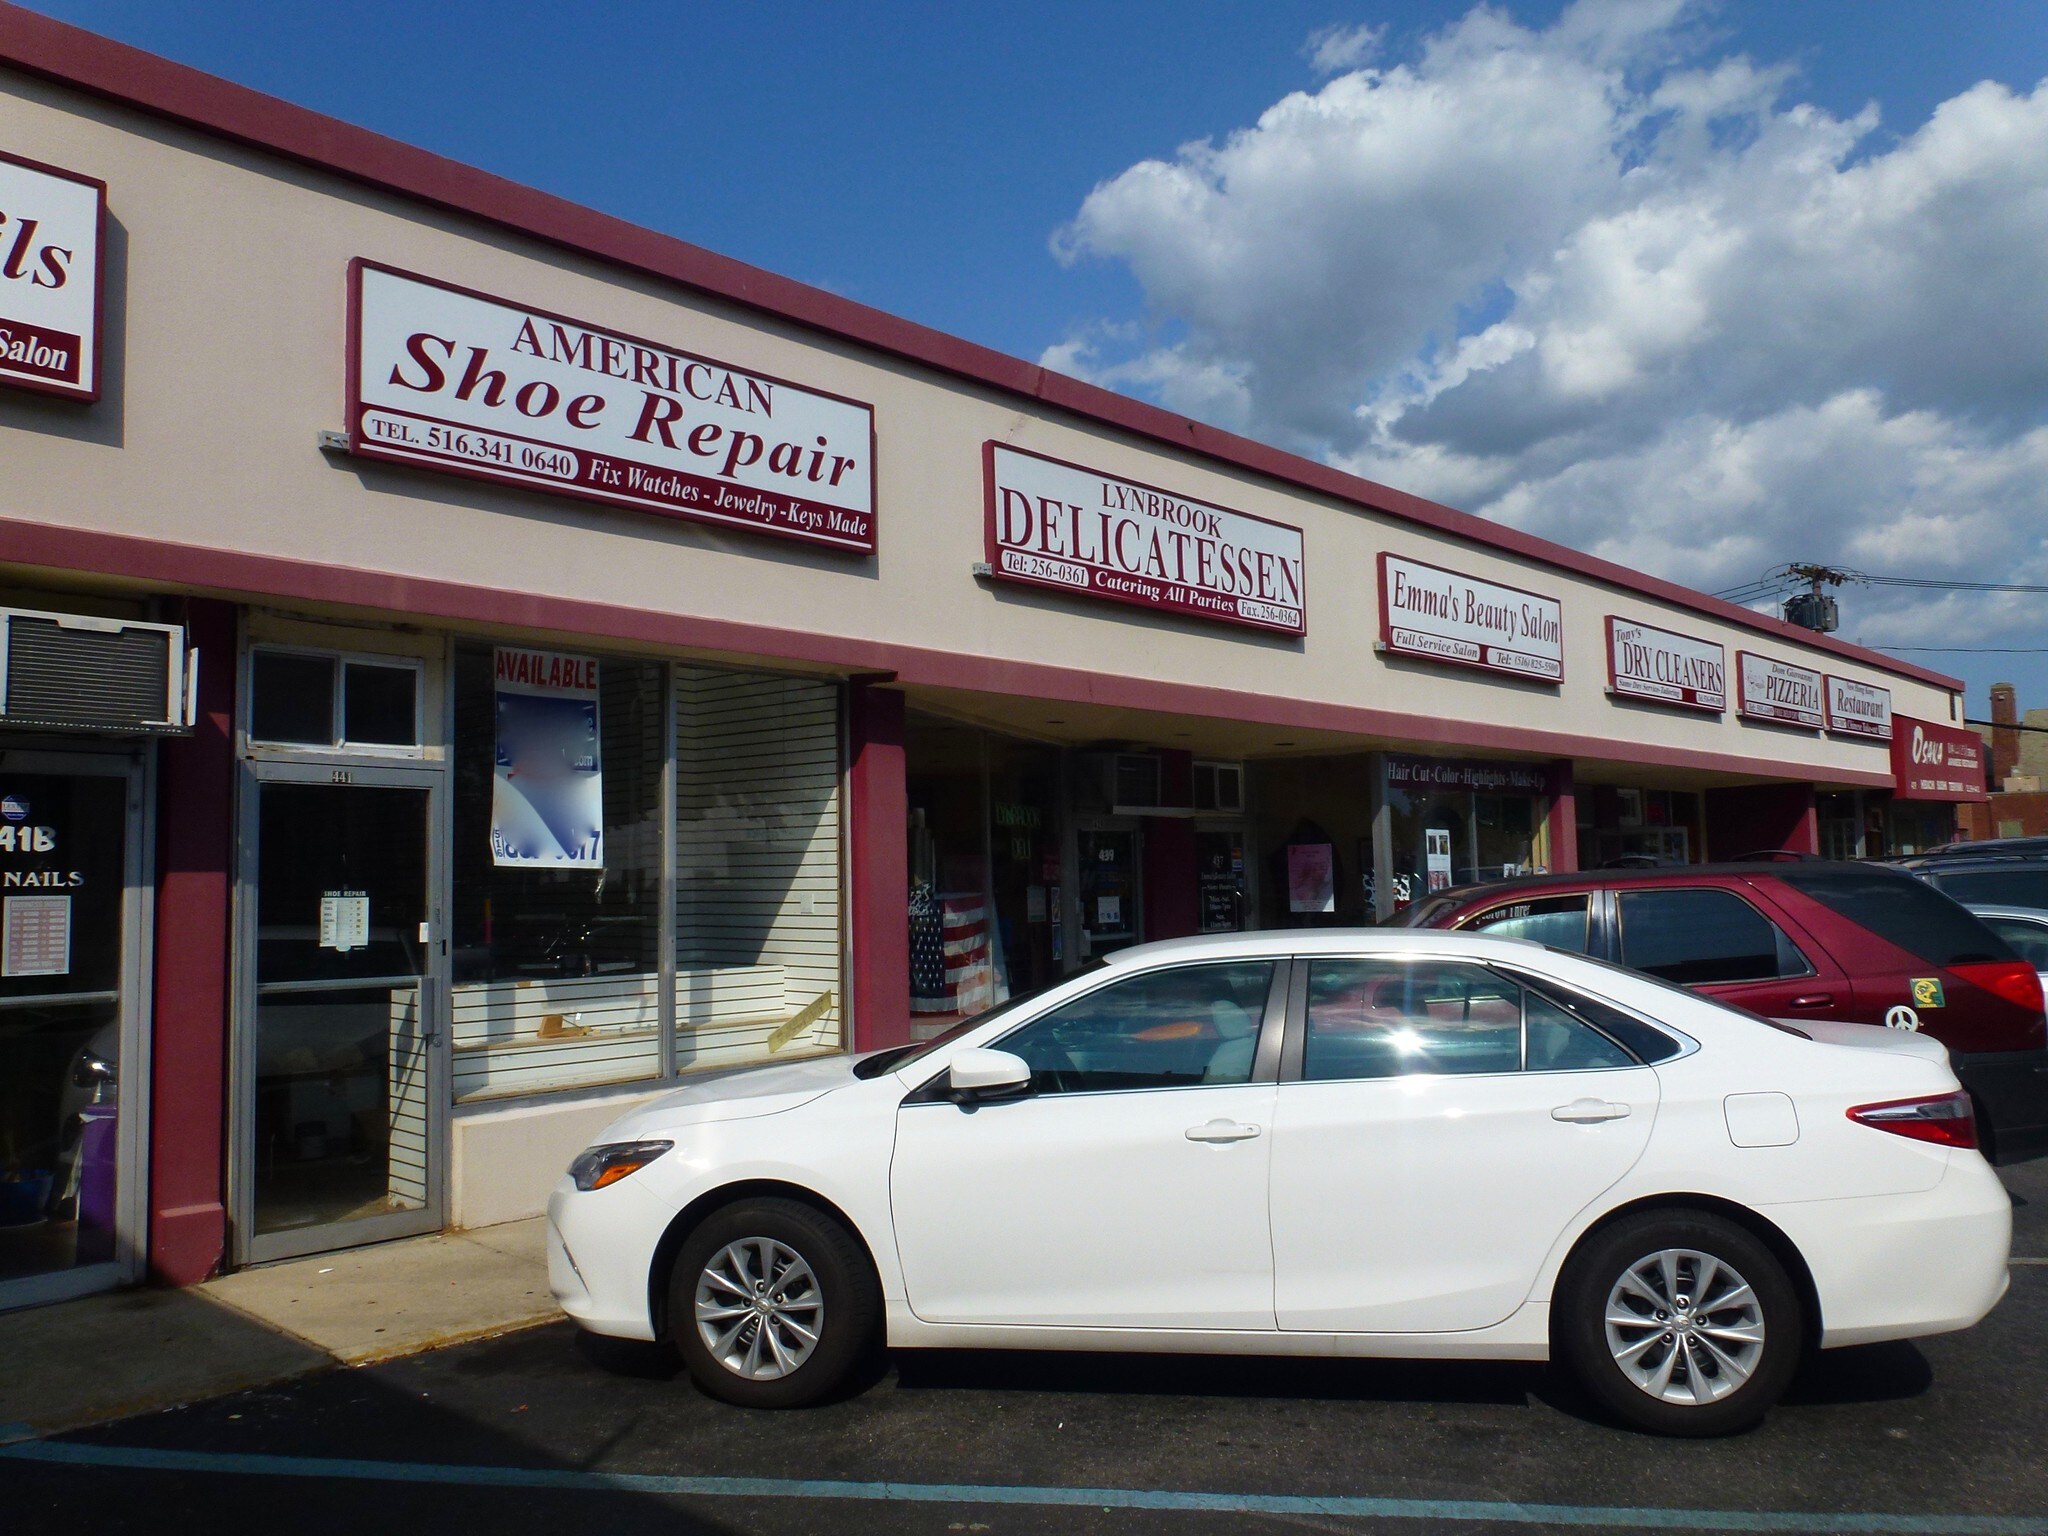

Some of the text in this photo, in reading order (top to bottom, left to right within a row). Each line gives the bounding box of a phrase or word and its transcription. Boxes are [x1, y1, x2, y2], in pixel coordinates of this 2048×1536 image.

[0, 211, 73, 289] ls
[510, 316, 774, 419] AMERICAN
[388, 333, 856, 487] Shoe Repair
[372, 418, 572, 476] TEL. 516.341 0640
[588, 459, 622, 485] Fix
[627, 466, 700, 501] Watches
[714, 486, 777, 522] Jewelry
[827, 510, 867, 536] Made
[1102, 482, 1223, 539] LYNBROOK
[999, 486, 1300, 606] DELICATESSEN
[1006, 552, 1086, 585] Tel: 256-0361
[1095, 570, 1235, 613] Catering All Parties
[1393, 569, 1558, 644] Emma's Beauty Salon
[1260, 604, 1298, 626] 256-0364
[1615, 627, 1642, 643] Tony's
[1395, 631, 1478, 658] Full Service Salon
[1496, 650, 1512, 665] Tel:
[496, 650, 597, 690] AVAILABLE
[1623, 641, 1723, 693] DRY CLEANERS
[1766, 674, 1819, 711] PIZZERIA
[1837, 687, 1884, 719] Restaurant
[1387, 761, 1410, 781] Hair
[1099, 849, 1115, 862] 439
[4, 871, 84, 888] NAILS
